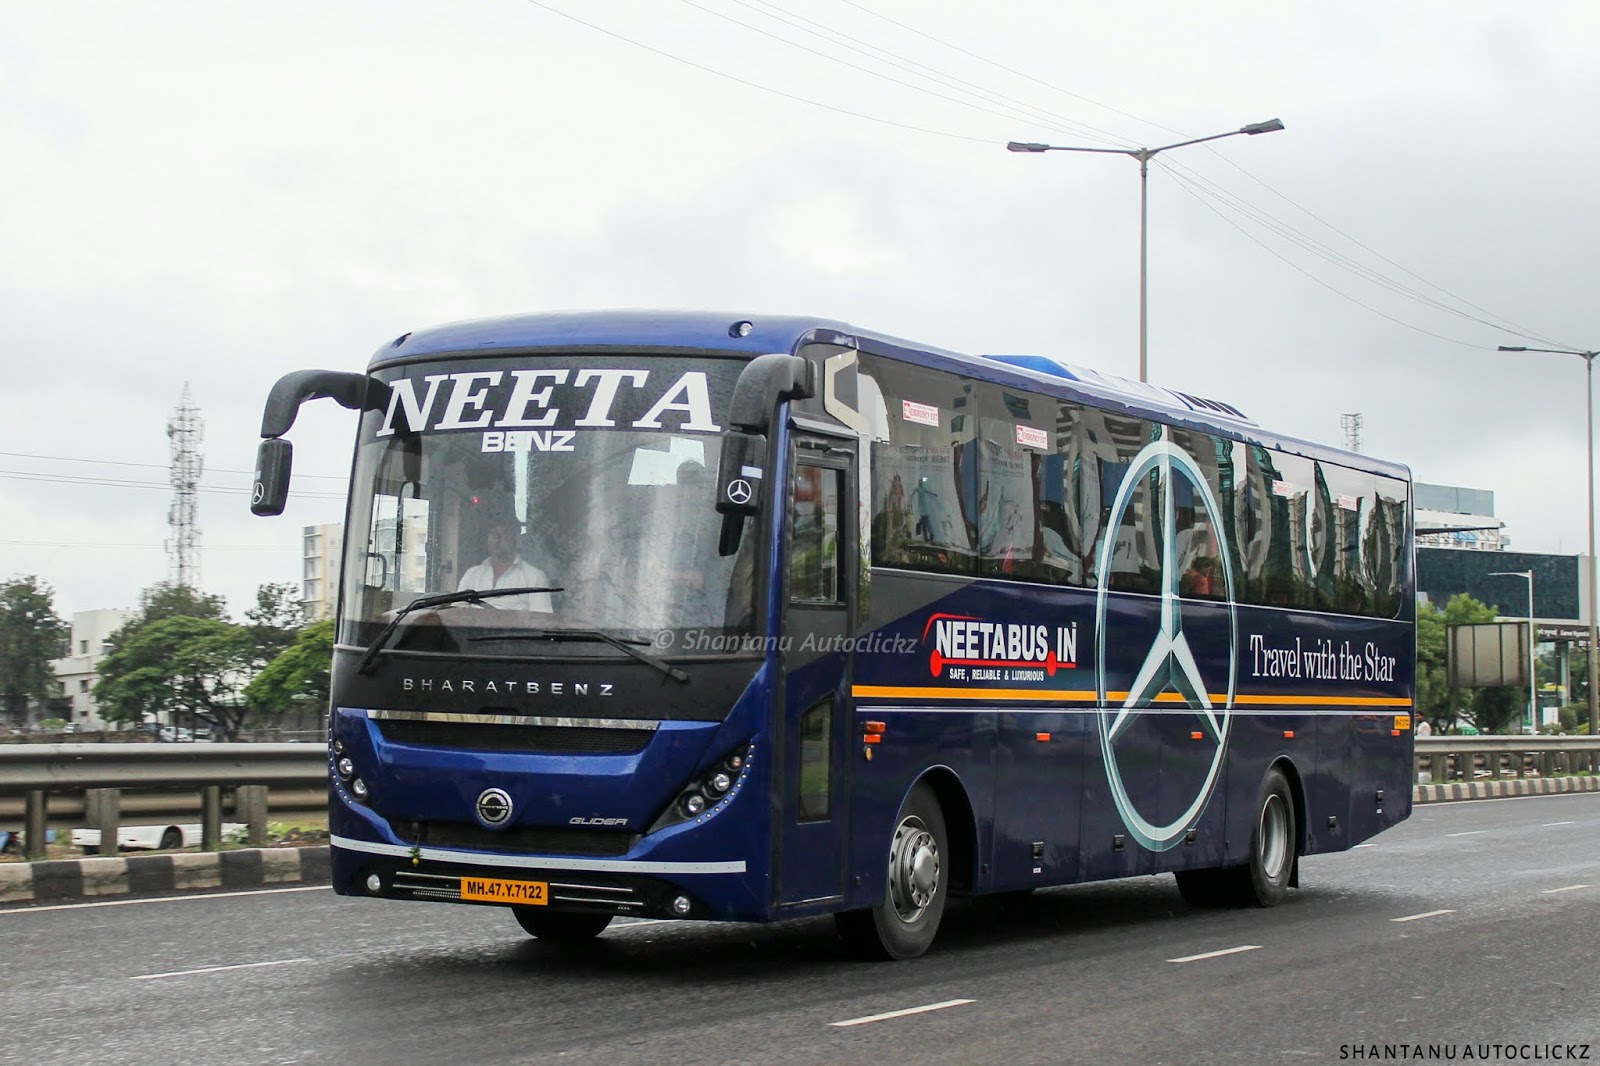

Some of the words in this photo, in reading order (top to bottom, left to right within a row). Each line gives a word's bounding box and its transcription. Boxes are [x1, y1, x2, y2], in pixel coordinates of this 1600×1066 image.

[376, 368, 721, 437] NEETA
[481, 430, 576, 452] BENZ
[1250, 634, 1301, 678] Travel
[1303, 638, 1337, 680] with
[1339, 640, 1362, 680] the
[1365, 641, 1396, 682] Star
[972, 669, 1001, 680] RELIABLE
[1004, 669, 1009, 680] &
[1012, 670, 1044, 682] LUXURIOUS
[403, 678, 613, 696] BHARATBENZ
[569, 817, 628, 826] GLIDER
[467, 881, 542, 899] MH.47.Y.7122
